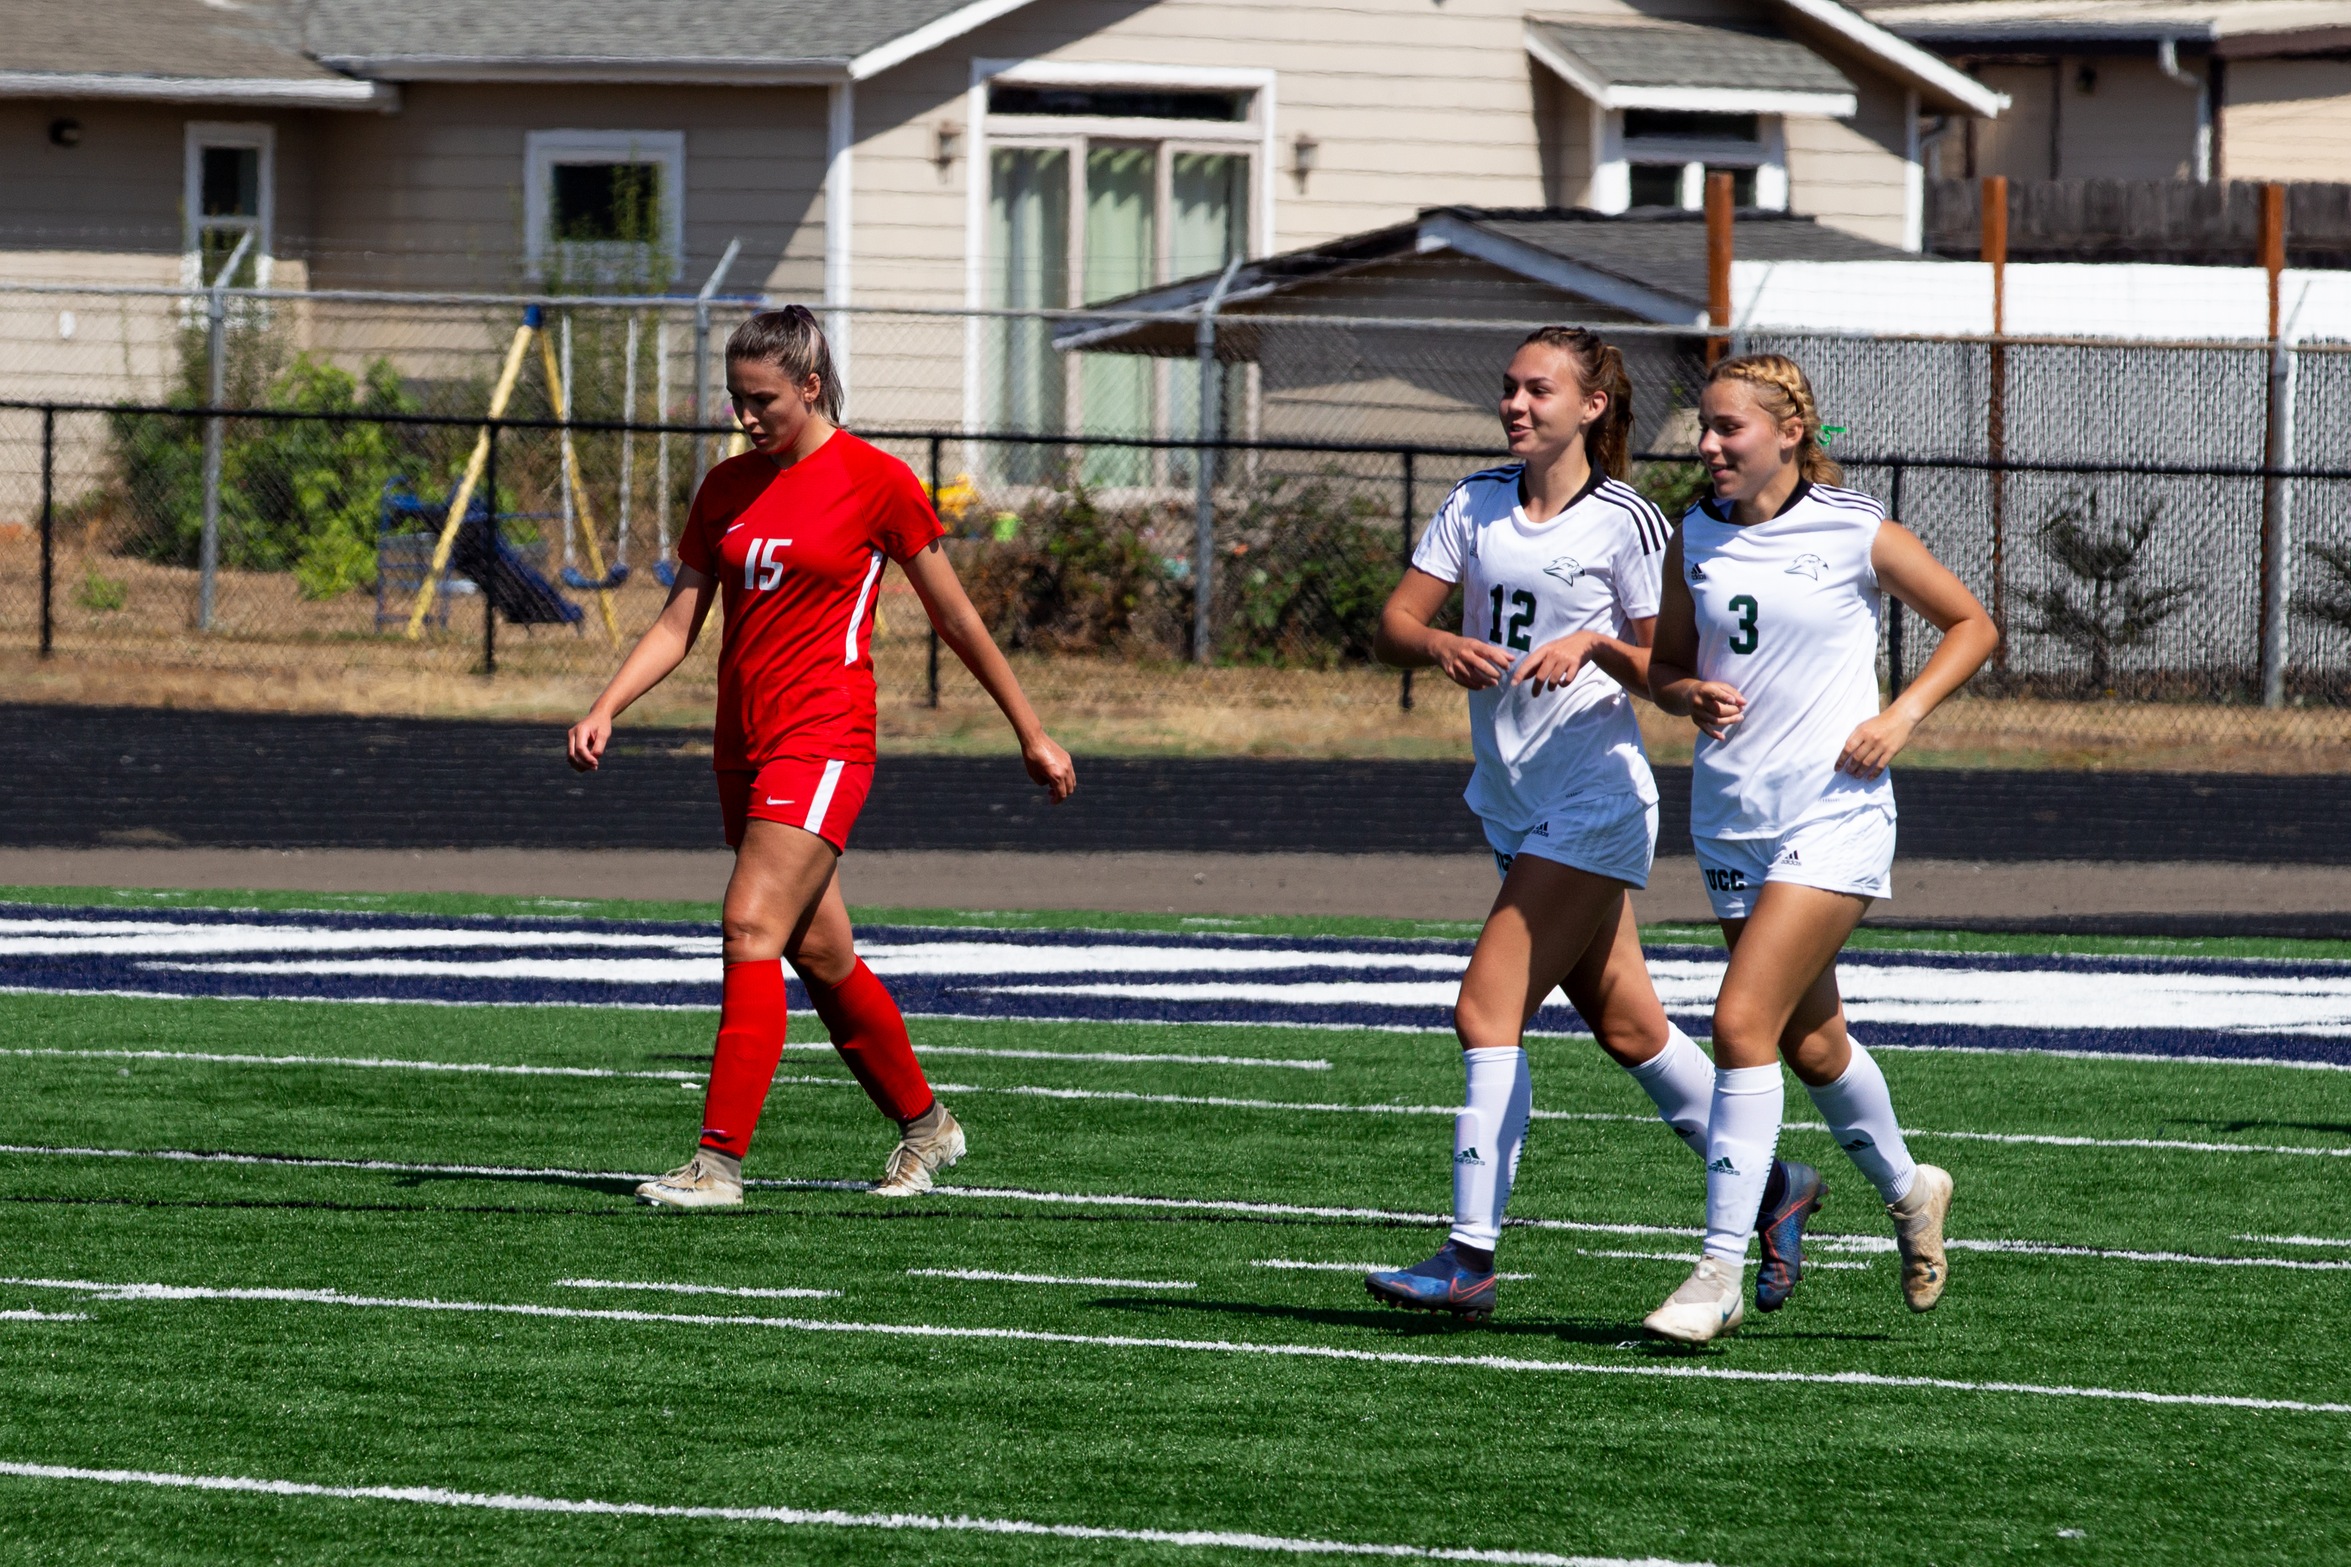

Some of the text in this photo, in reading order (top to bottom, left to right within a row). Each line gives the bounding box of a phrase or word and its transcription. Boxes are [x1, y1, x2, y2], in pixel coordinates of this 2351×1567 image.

[745, 538, 793, 590] 15
[1489, 584, 1537, 652] 12
[1728, 595, 1759, 655] 3
[1705, 869, 1746, 891] UCC
